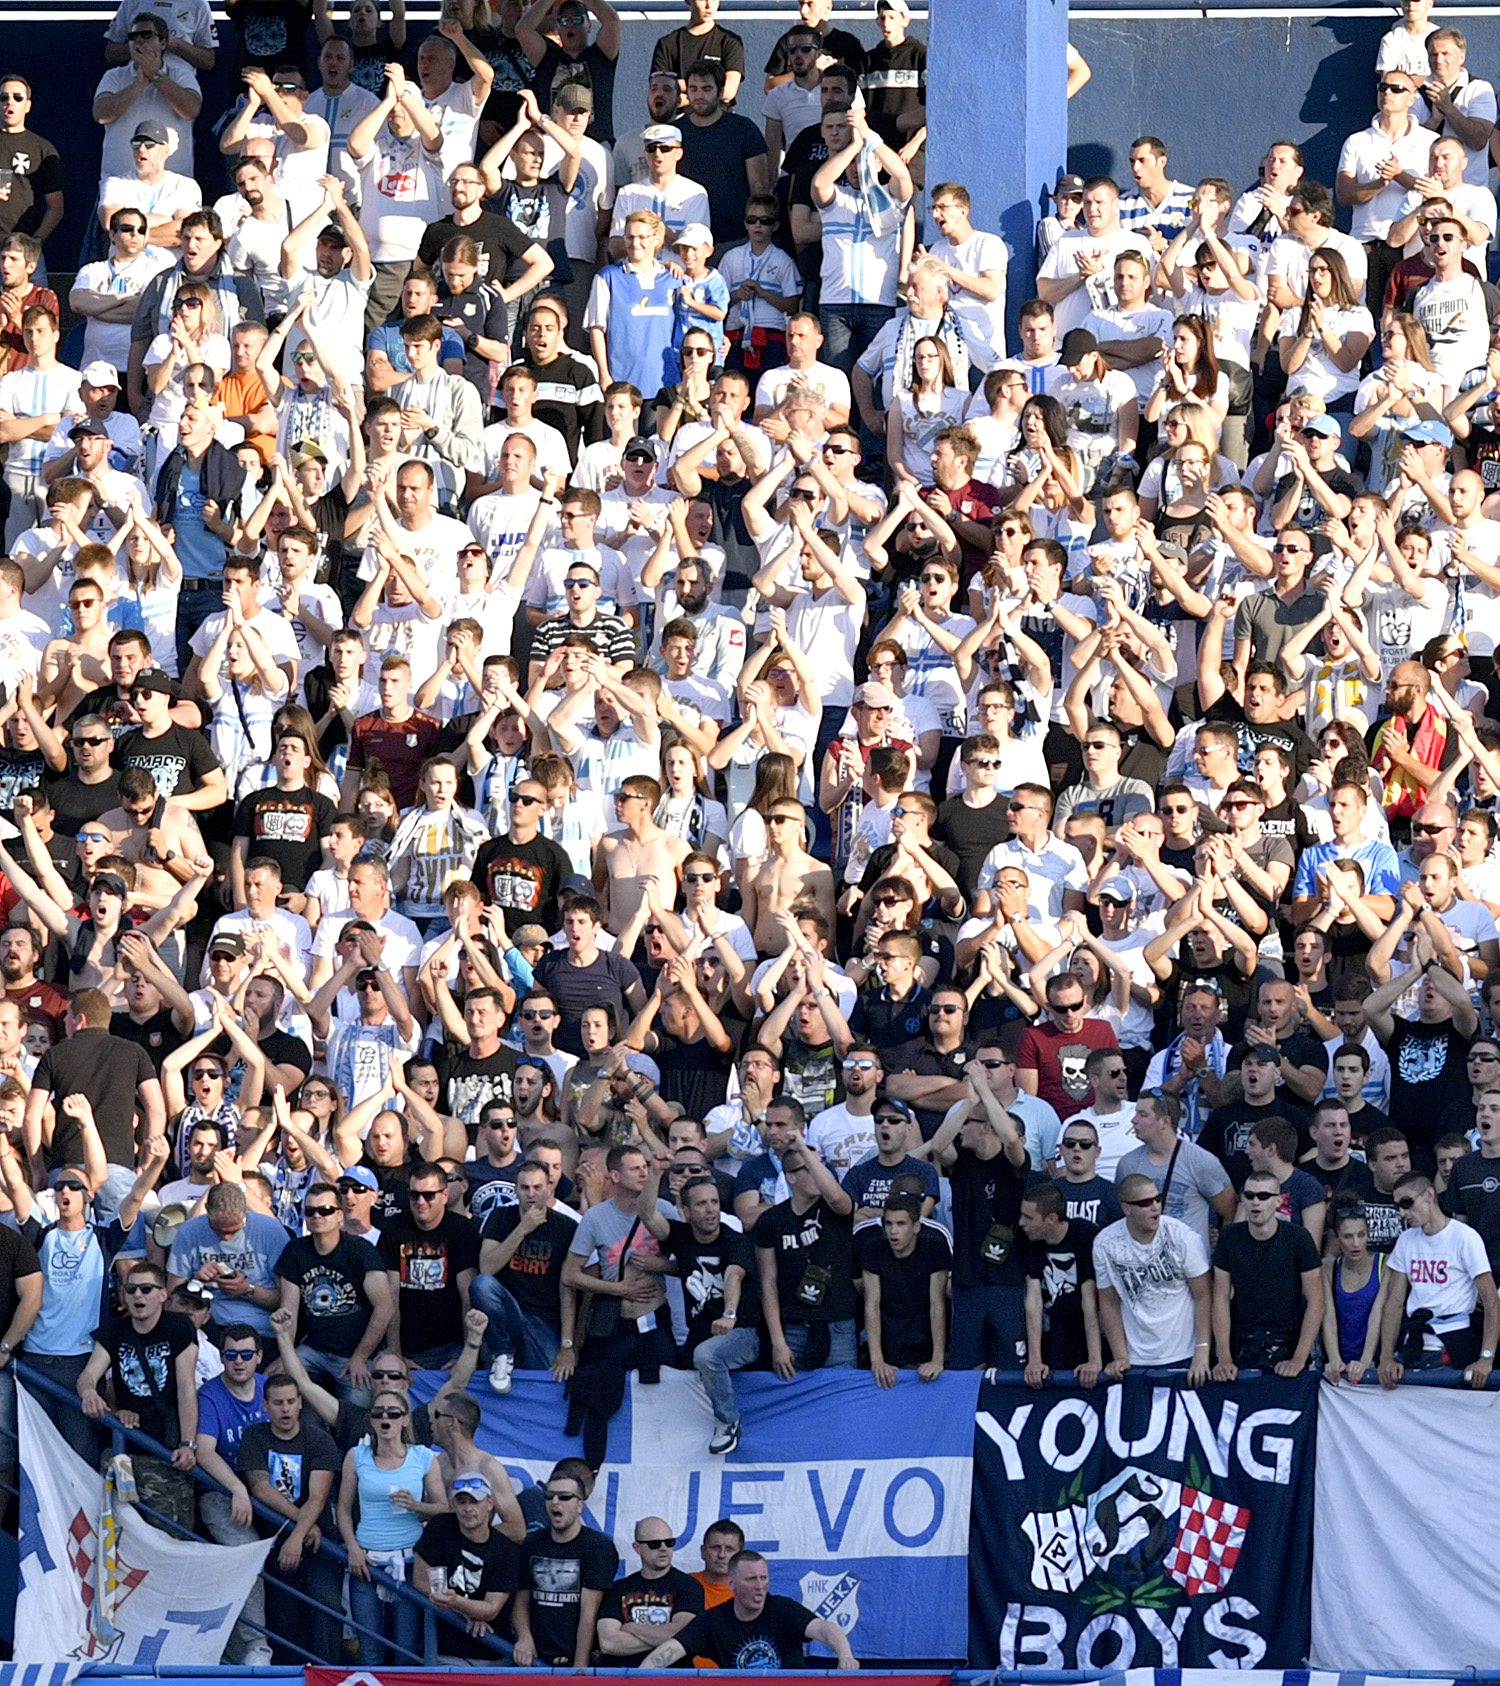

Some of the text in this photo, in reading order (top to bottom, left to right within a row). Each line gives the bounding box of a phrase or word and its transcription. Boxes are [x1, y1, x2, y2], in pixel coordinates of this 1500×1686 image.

[1410, 1260, 1448, 1284] HNS
[975, 1384, 1302, 1485] YOUNG
[807, 1579, 830, 1593] HNK
[815, 1575, 859, 1620] IJEKA
[1000, 1596, 1267, 1670] BOYS
